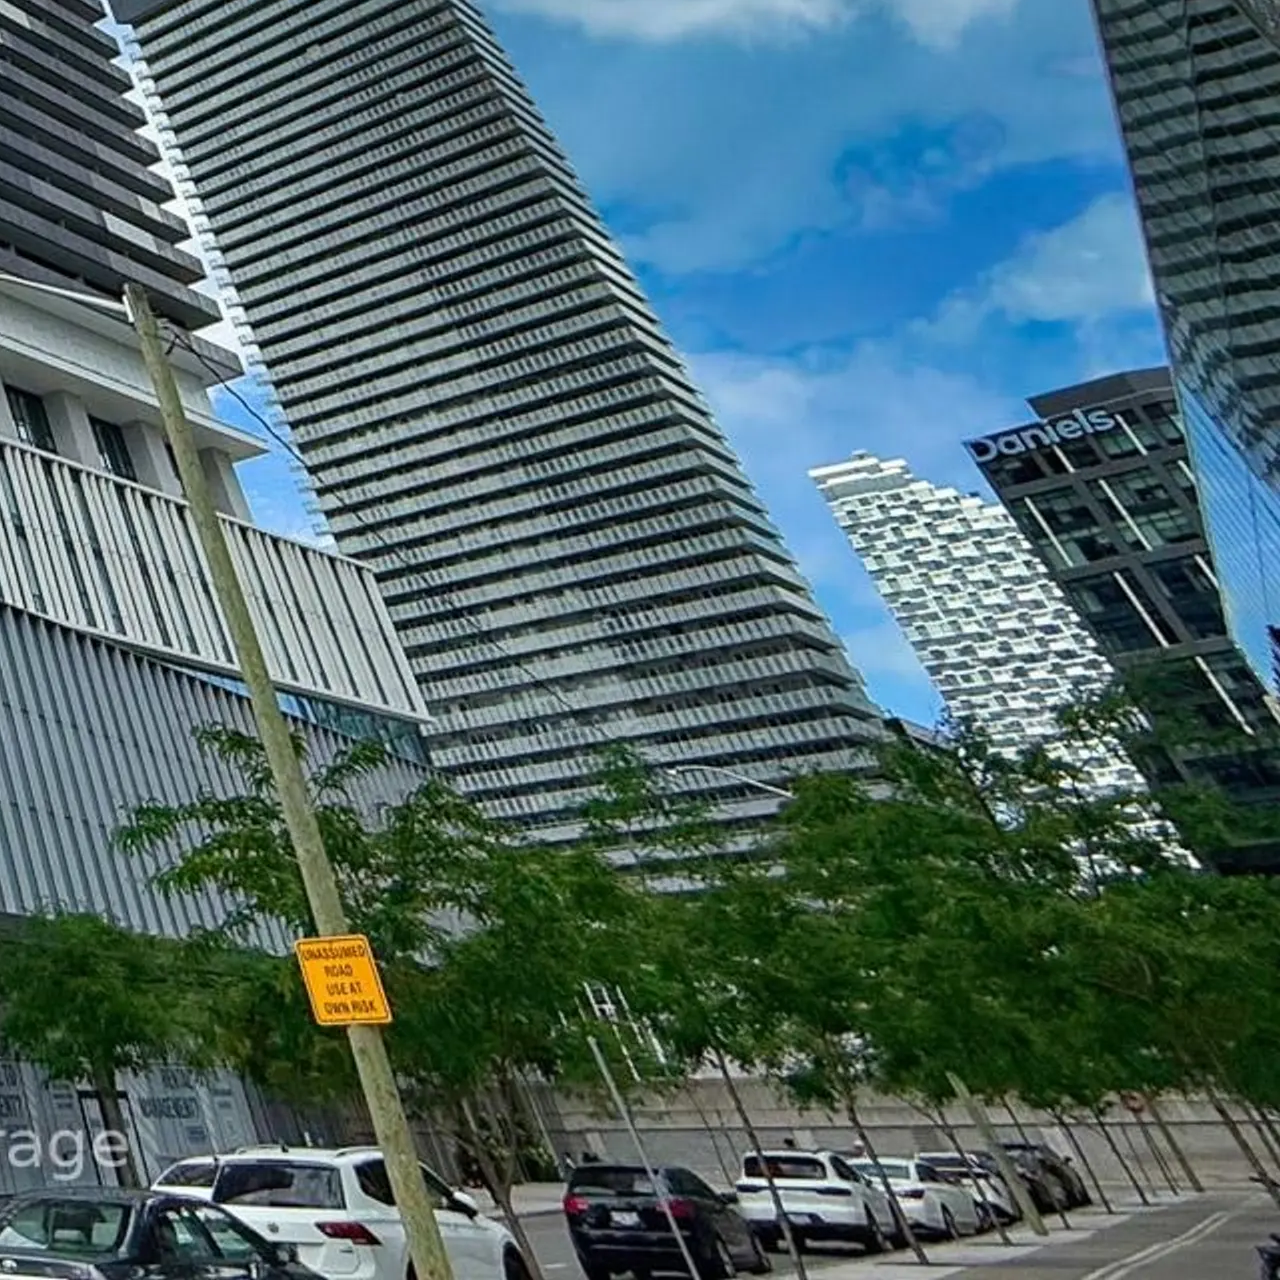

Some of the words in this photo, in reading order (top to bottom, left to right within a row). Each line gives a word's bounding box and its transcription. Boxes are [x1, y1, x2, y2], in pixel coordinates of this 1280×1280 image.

[969, 408, 1116, 463] Daniels
[324, 963, 353, 977] ROAD
[326, 982, 348, 996] USE
[350, 981, 362, 995] AT
[324, 1001, 351, 1015] OWN
